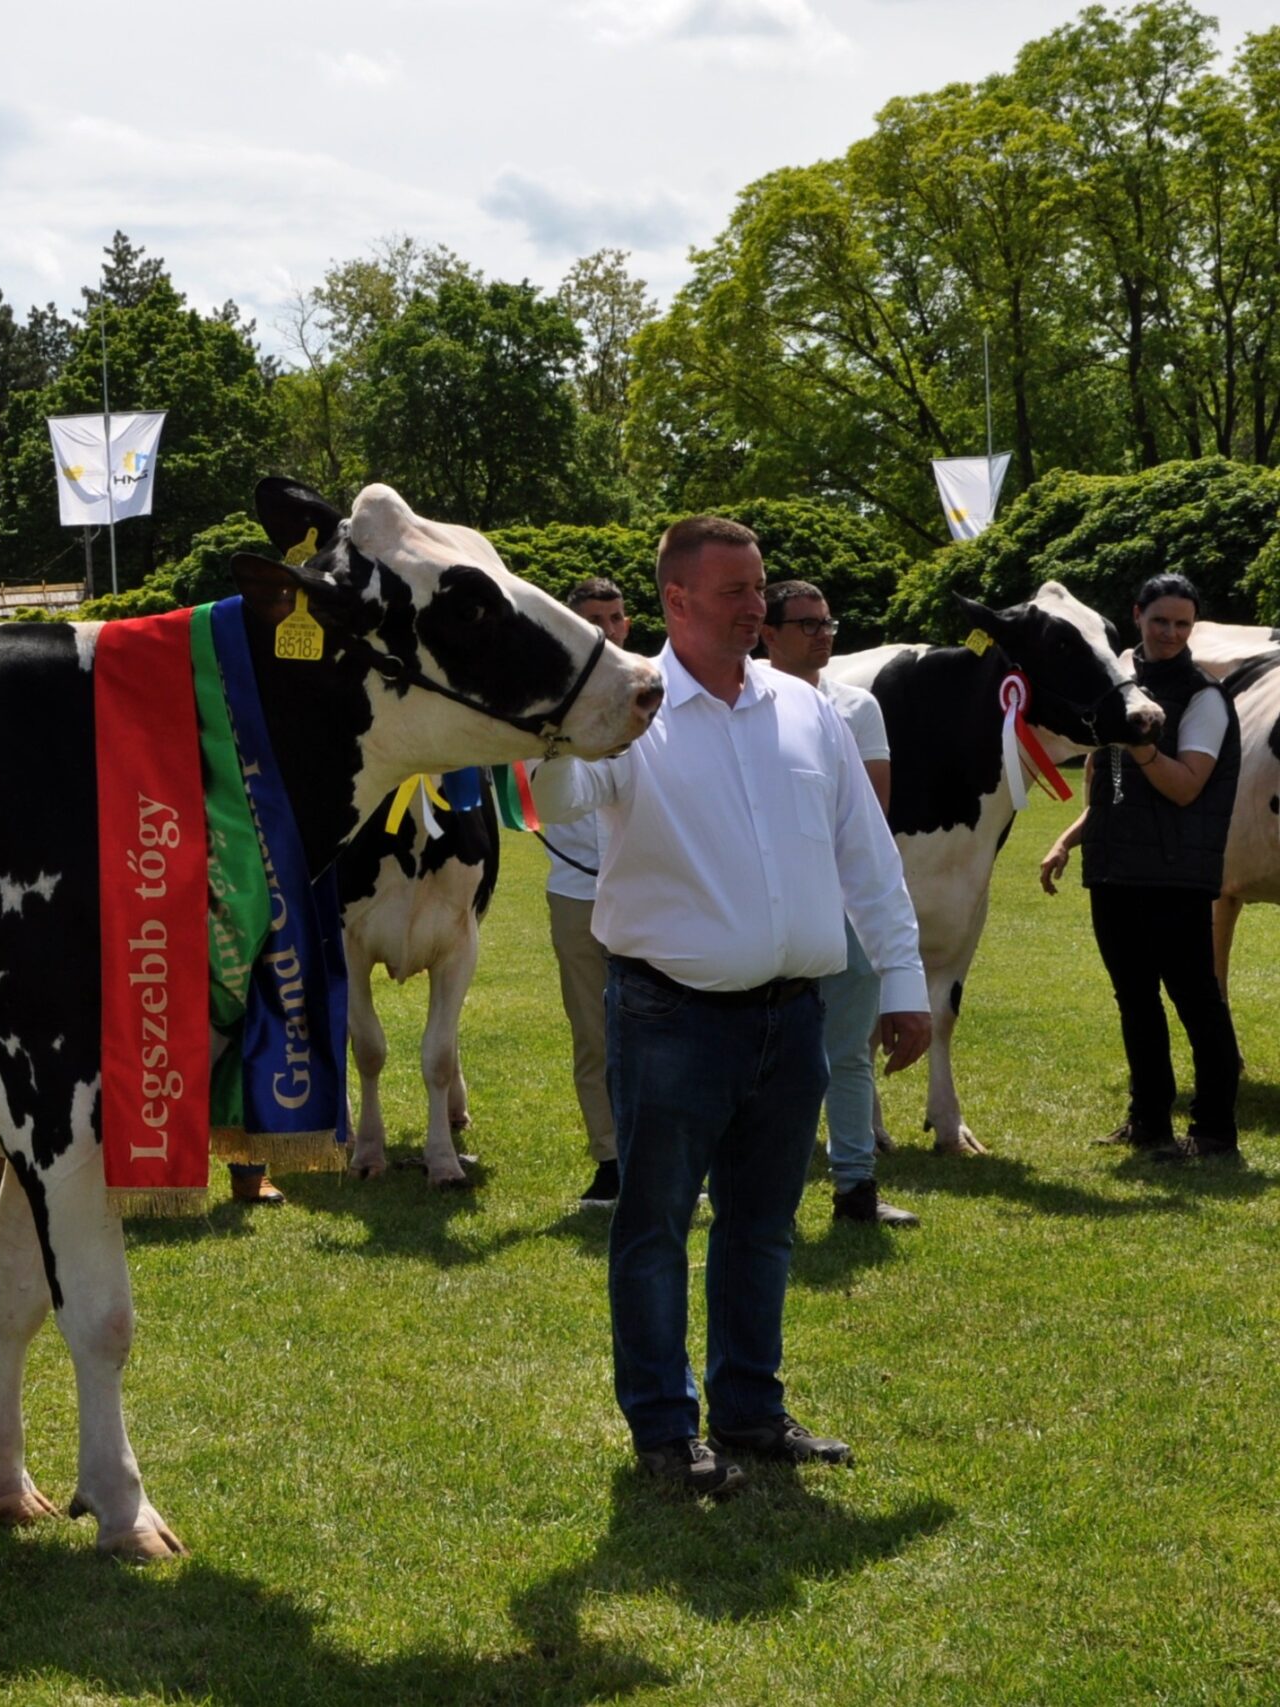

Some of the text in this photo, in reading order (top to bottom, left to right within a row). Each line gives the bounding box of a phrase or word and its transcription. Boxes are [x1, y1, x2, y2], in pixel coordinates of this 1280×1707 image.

[126, 791, 183, 1163] Legszebb tőgy
[264, 944, 312, 1110] Grand
